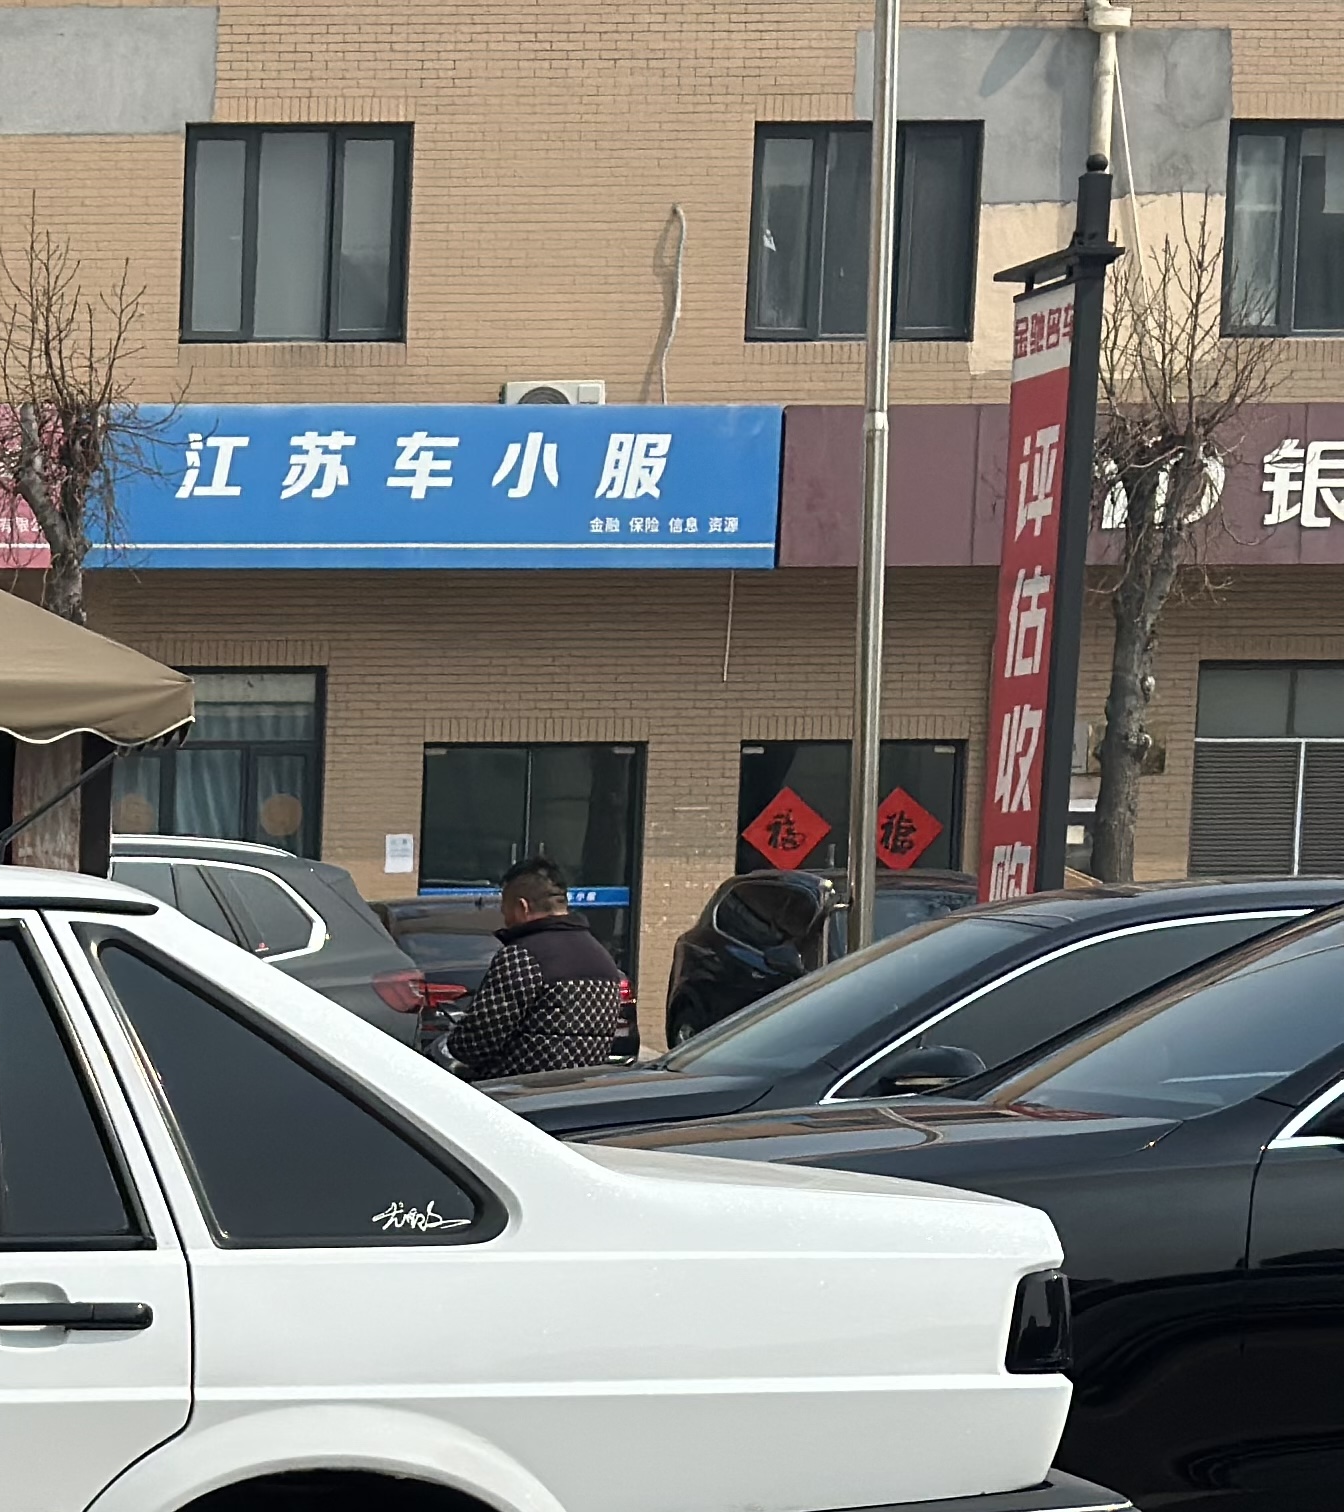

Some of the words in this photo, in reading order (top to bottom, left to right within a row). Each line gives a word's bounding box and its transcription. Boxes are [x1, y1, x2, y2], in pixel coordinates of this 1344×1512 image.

[175, 430, 672, 500] 江苏车小服
[589, 516, 620, 533] 金融
[629, 516, 660, 533] 保险
[668, 516, 699, 533] 信息
[708, 516, 739, 533] 资源
